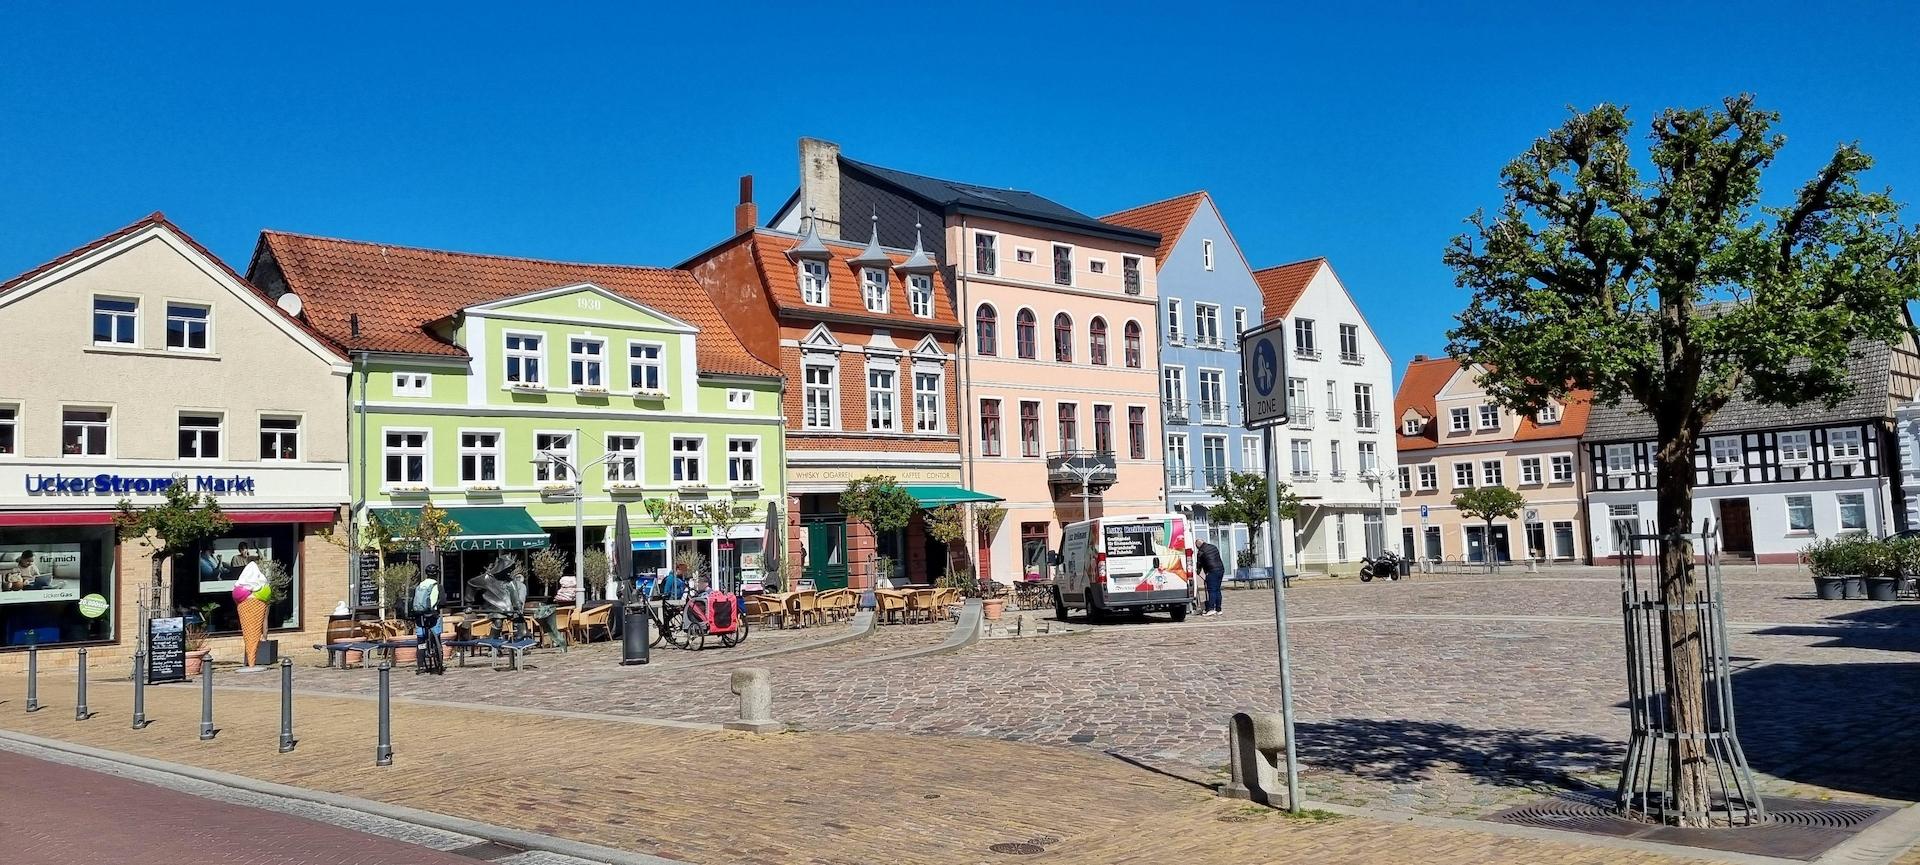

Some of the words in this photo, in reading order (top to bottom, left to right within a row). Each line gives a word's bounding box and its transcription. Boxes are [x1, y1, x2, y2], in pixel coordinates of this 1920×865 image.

[576, 297, 601, 311] 1930
[1257, 398, 1277, 415] ZONE
[796, 471, 820, 479] WHISKY
[822, 471, 853, 479] CIGARREN
[901, 471, 921, 479] KAFFEE
[196, 474, 255, 494] Markt
[1422, 506, 1426, 516] P
